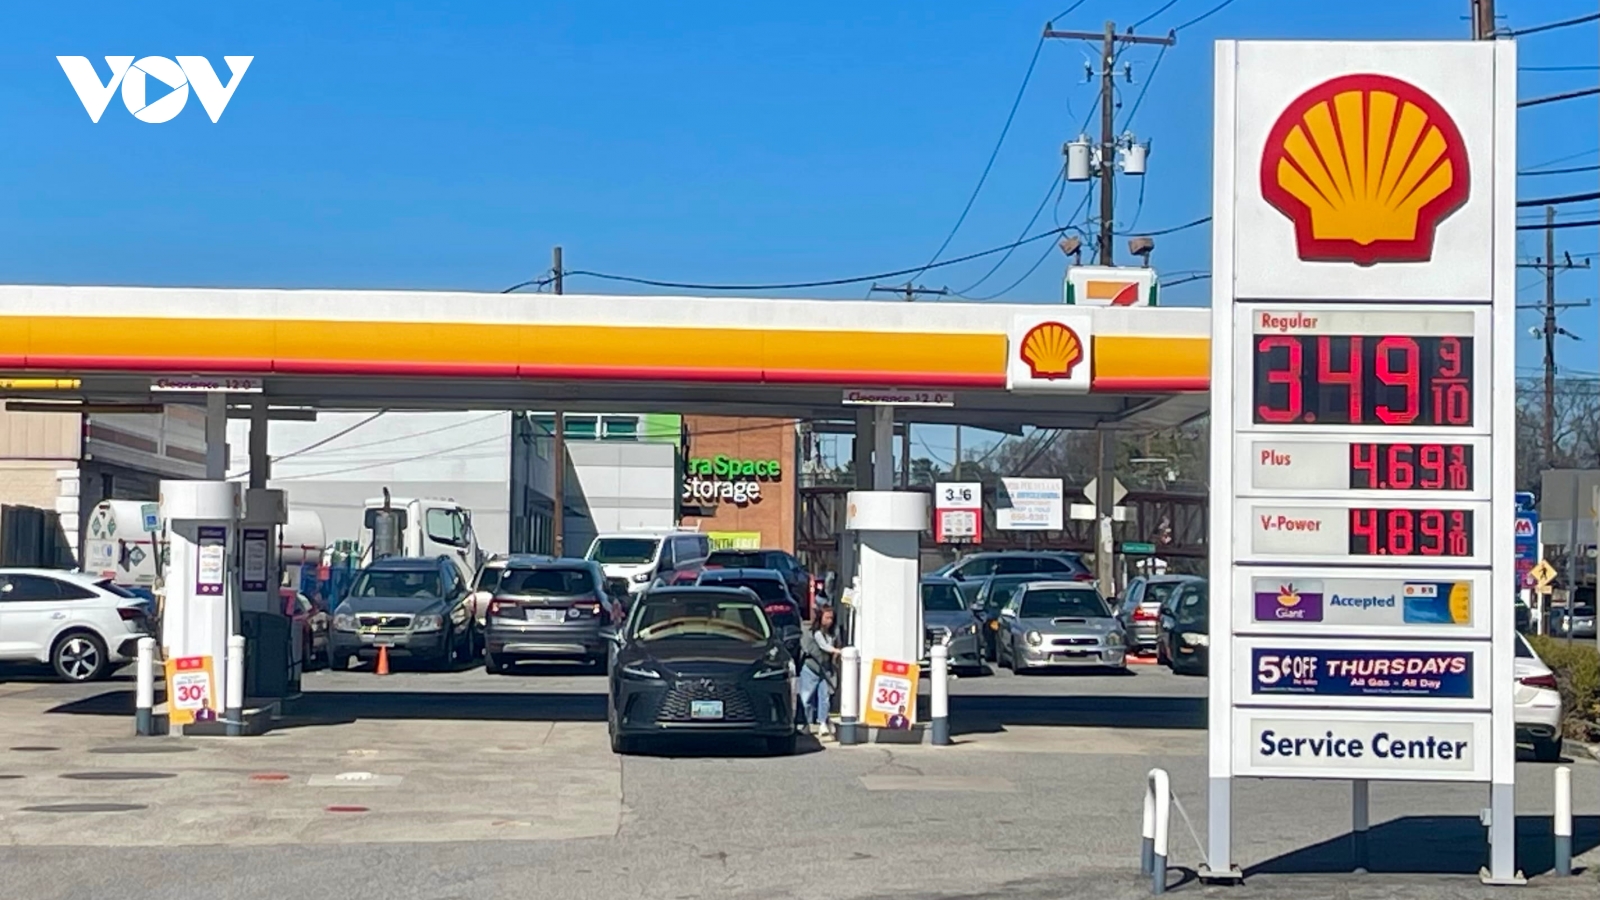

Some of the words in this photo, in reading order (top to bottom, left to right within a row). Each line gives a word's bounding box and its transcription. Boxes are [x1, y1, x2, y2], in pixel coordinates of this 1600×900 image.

[1261, 313, 1318, 332] Regular
[1258, 336, 1420, 425] 3.49
[1260, 450, 1291, 466] Plus
[1353, 443, 1445, 489] 4.69
[1260, 515, 1321, 531] V-Power
[1353, 508, 1445, 555] 4.89
[1330, 594, 1395, 610] Accepted
[1275, 607, 1303, 619] Giant
[1293, 656, 1318, 678] OFF
[1326, 657, 1466, 677] THURSDAYS
[1368, 677, 1391, 687] Gas
[1420, 679, 1441, 689] Day
[1260, 730, 1364, 758] Service
[1371, 732, 1468, 760] Center
